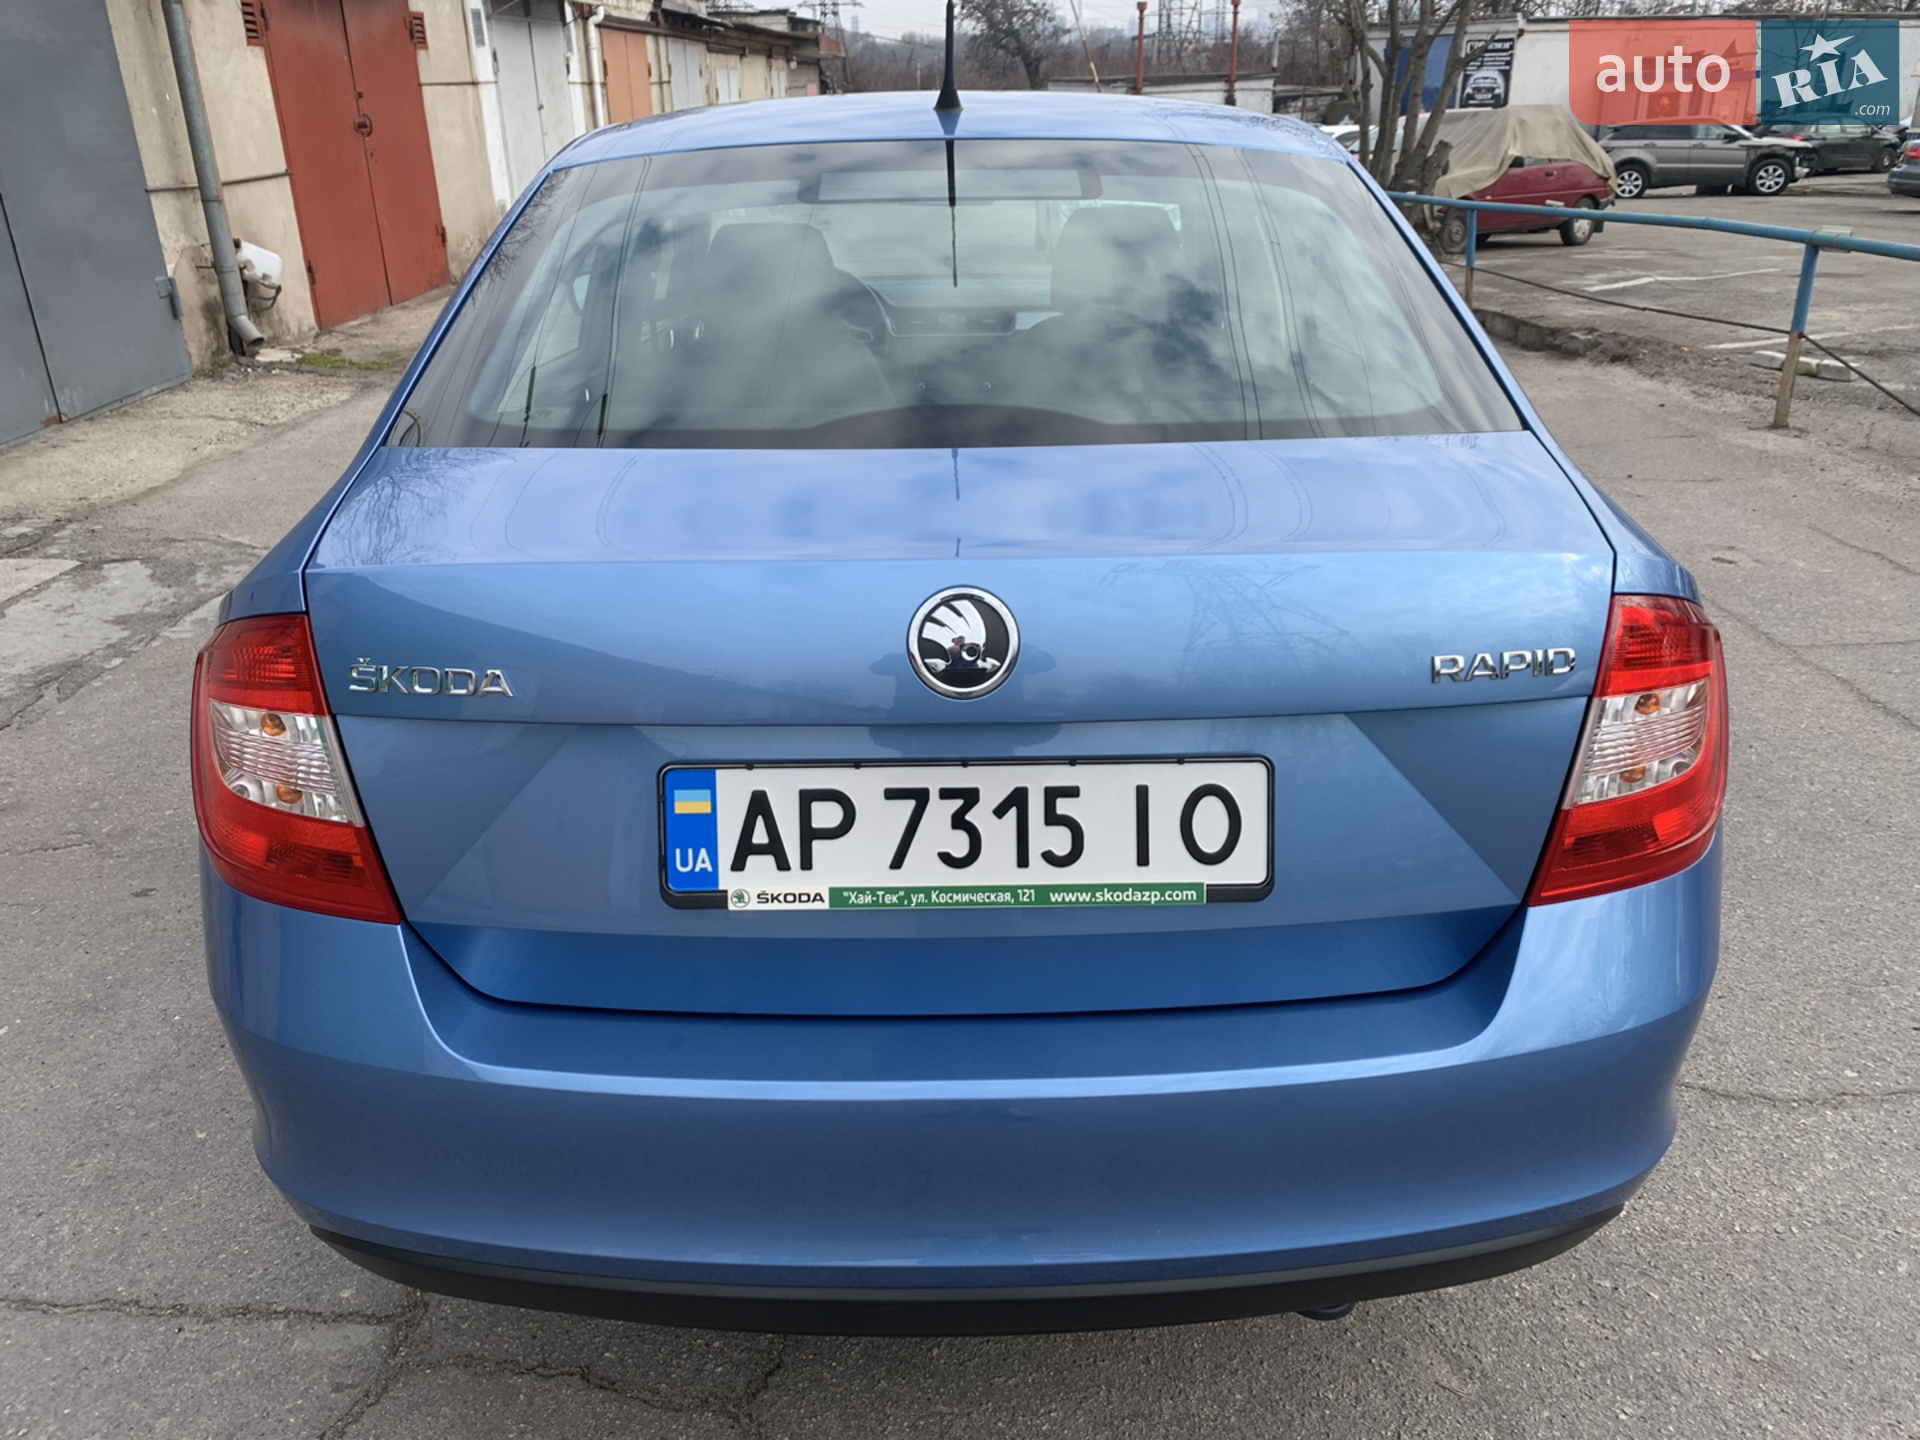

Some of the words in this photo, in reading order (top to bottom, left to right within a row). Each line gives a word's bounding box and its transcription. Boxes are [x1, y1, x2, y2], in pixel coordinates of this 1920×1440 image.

[349, 657, 514, 697] ŠKODA
[1431, 647, 1576, 684] RAPID
[730, 788, 857, 872] AP
[883, 785, 1085, 871] 7315
[675, 848, 713, 873] UA
[756, 890, 825, 904] ŠKODA
[910, 893, 928, 907] ул.
[931, 889, 1014, 904] Космическая,
[1017, 888, 1036, 902] 121
[1049, 887, 1197, 904] www.skodazp.com
